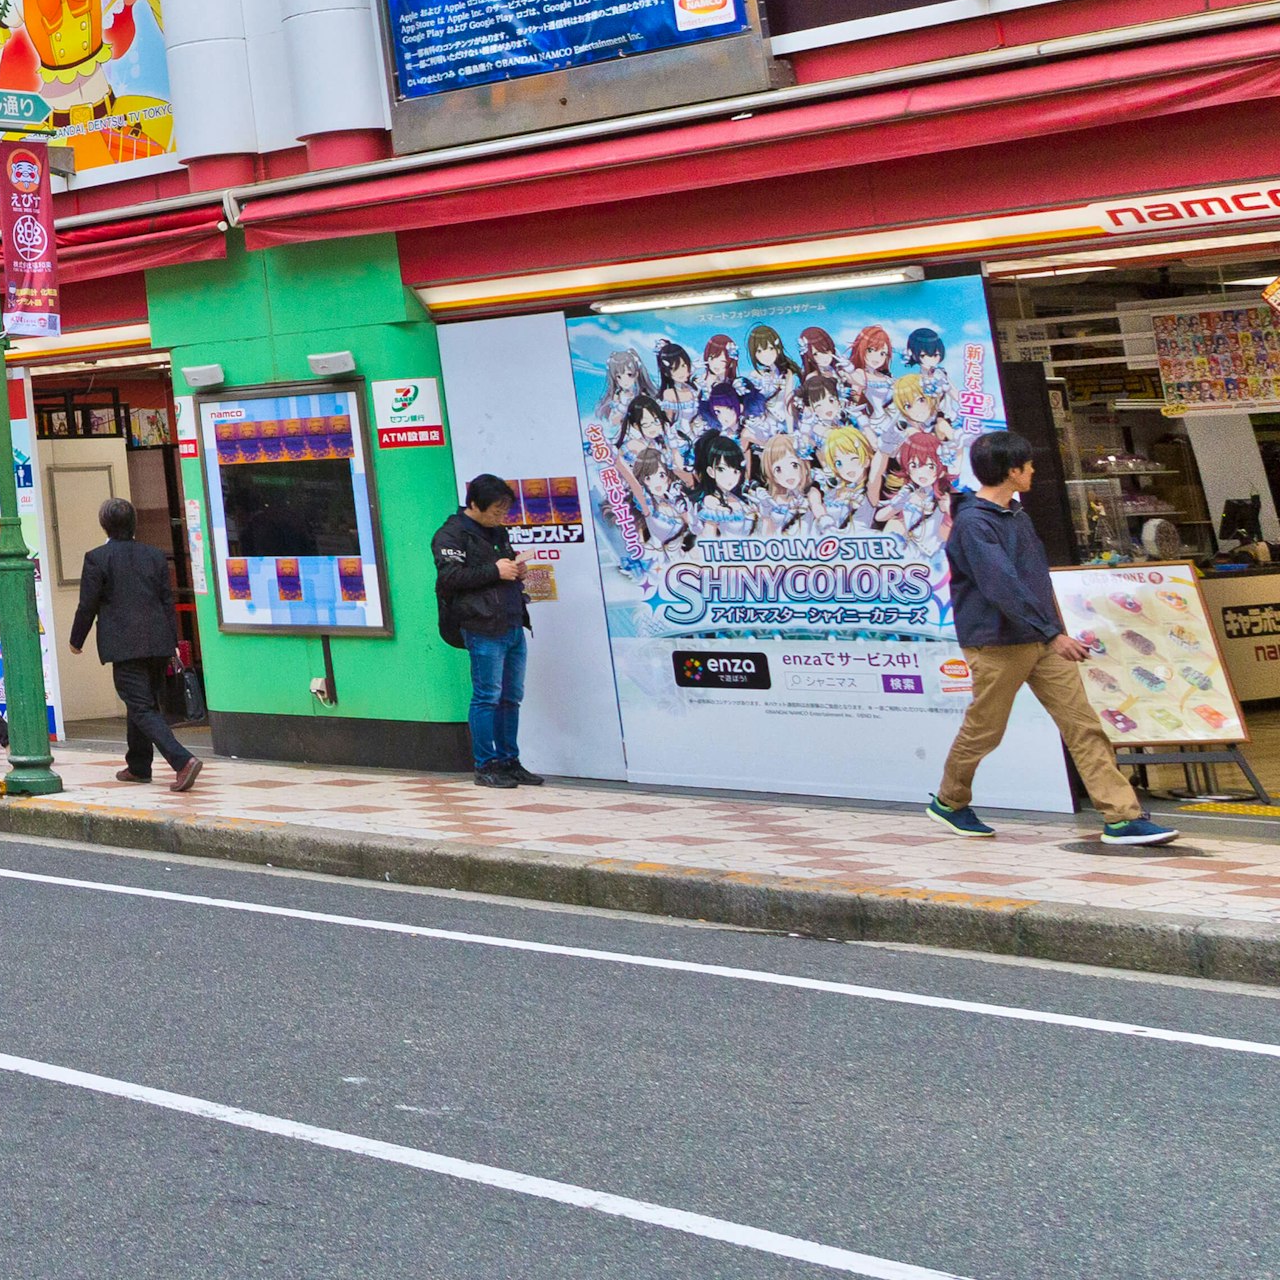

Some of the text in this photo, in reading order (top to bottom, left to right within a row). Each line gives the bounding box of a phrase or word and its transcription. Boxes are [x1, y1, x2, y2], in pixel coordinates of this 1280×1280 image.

[543, 0, 573, 15] Google
[539, 35, 628, 63] NAMCO Entertainment
[87, 116, 125, 132] DENTSU,
[128, 112, 141, 123] TV
[697, 302, 827, 322] スマートフォン向けブラウザゲーム
[960, 344, 985, 434] 新たな空に
[210, 408, 243, 420] namco
[381, 430, 440, 445] ATM設置店
[586, 423, 644, 561] さあ、飛び立とう
[712, 608, 928, 625] アイドルマスター シャイニーカラーズ
[706, 657, 756, 674] enza
[782, 652, 919, 669] enzaでサービス中!
[806, 676, 858, 689] シャニマス
[889, 678, 916, 692] 検索
